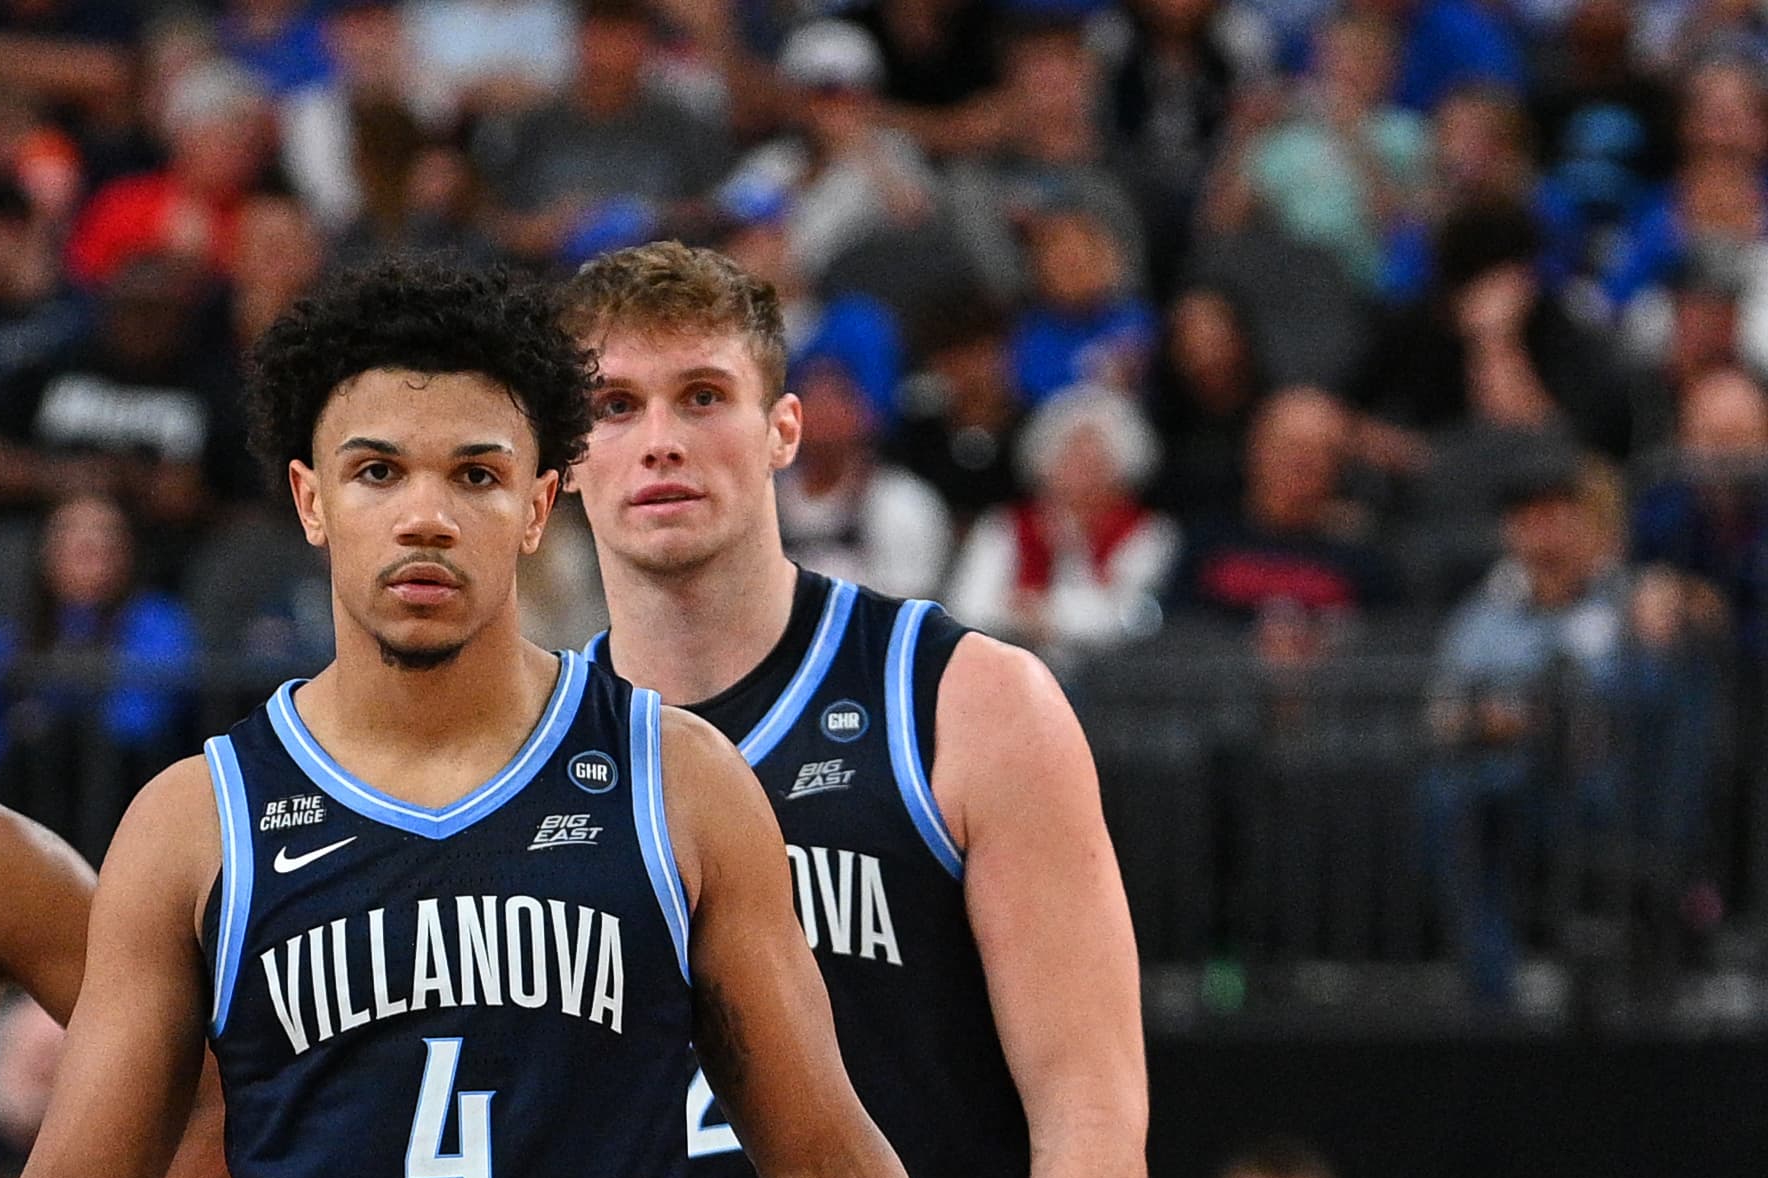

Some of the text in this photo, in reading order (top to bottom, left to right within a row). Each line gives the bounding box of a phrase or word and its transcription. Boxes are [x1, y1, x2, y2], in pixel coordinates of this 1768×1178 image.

[827, 712, 860, 730] GHR
[576, 762, 608, 782] GHR
[798, 758, 843, 777] BIG
[792, 769, 856, 791] EAST
[265, 795, 322, 816] BE THE
[259, 808, 324, 831] CHANGE
[540, 814, 591, 829] BIG
[533, 827, 604, 843] EAST
[260, 895, 624, 1055] VILLANOVA
